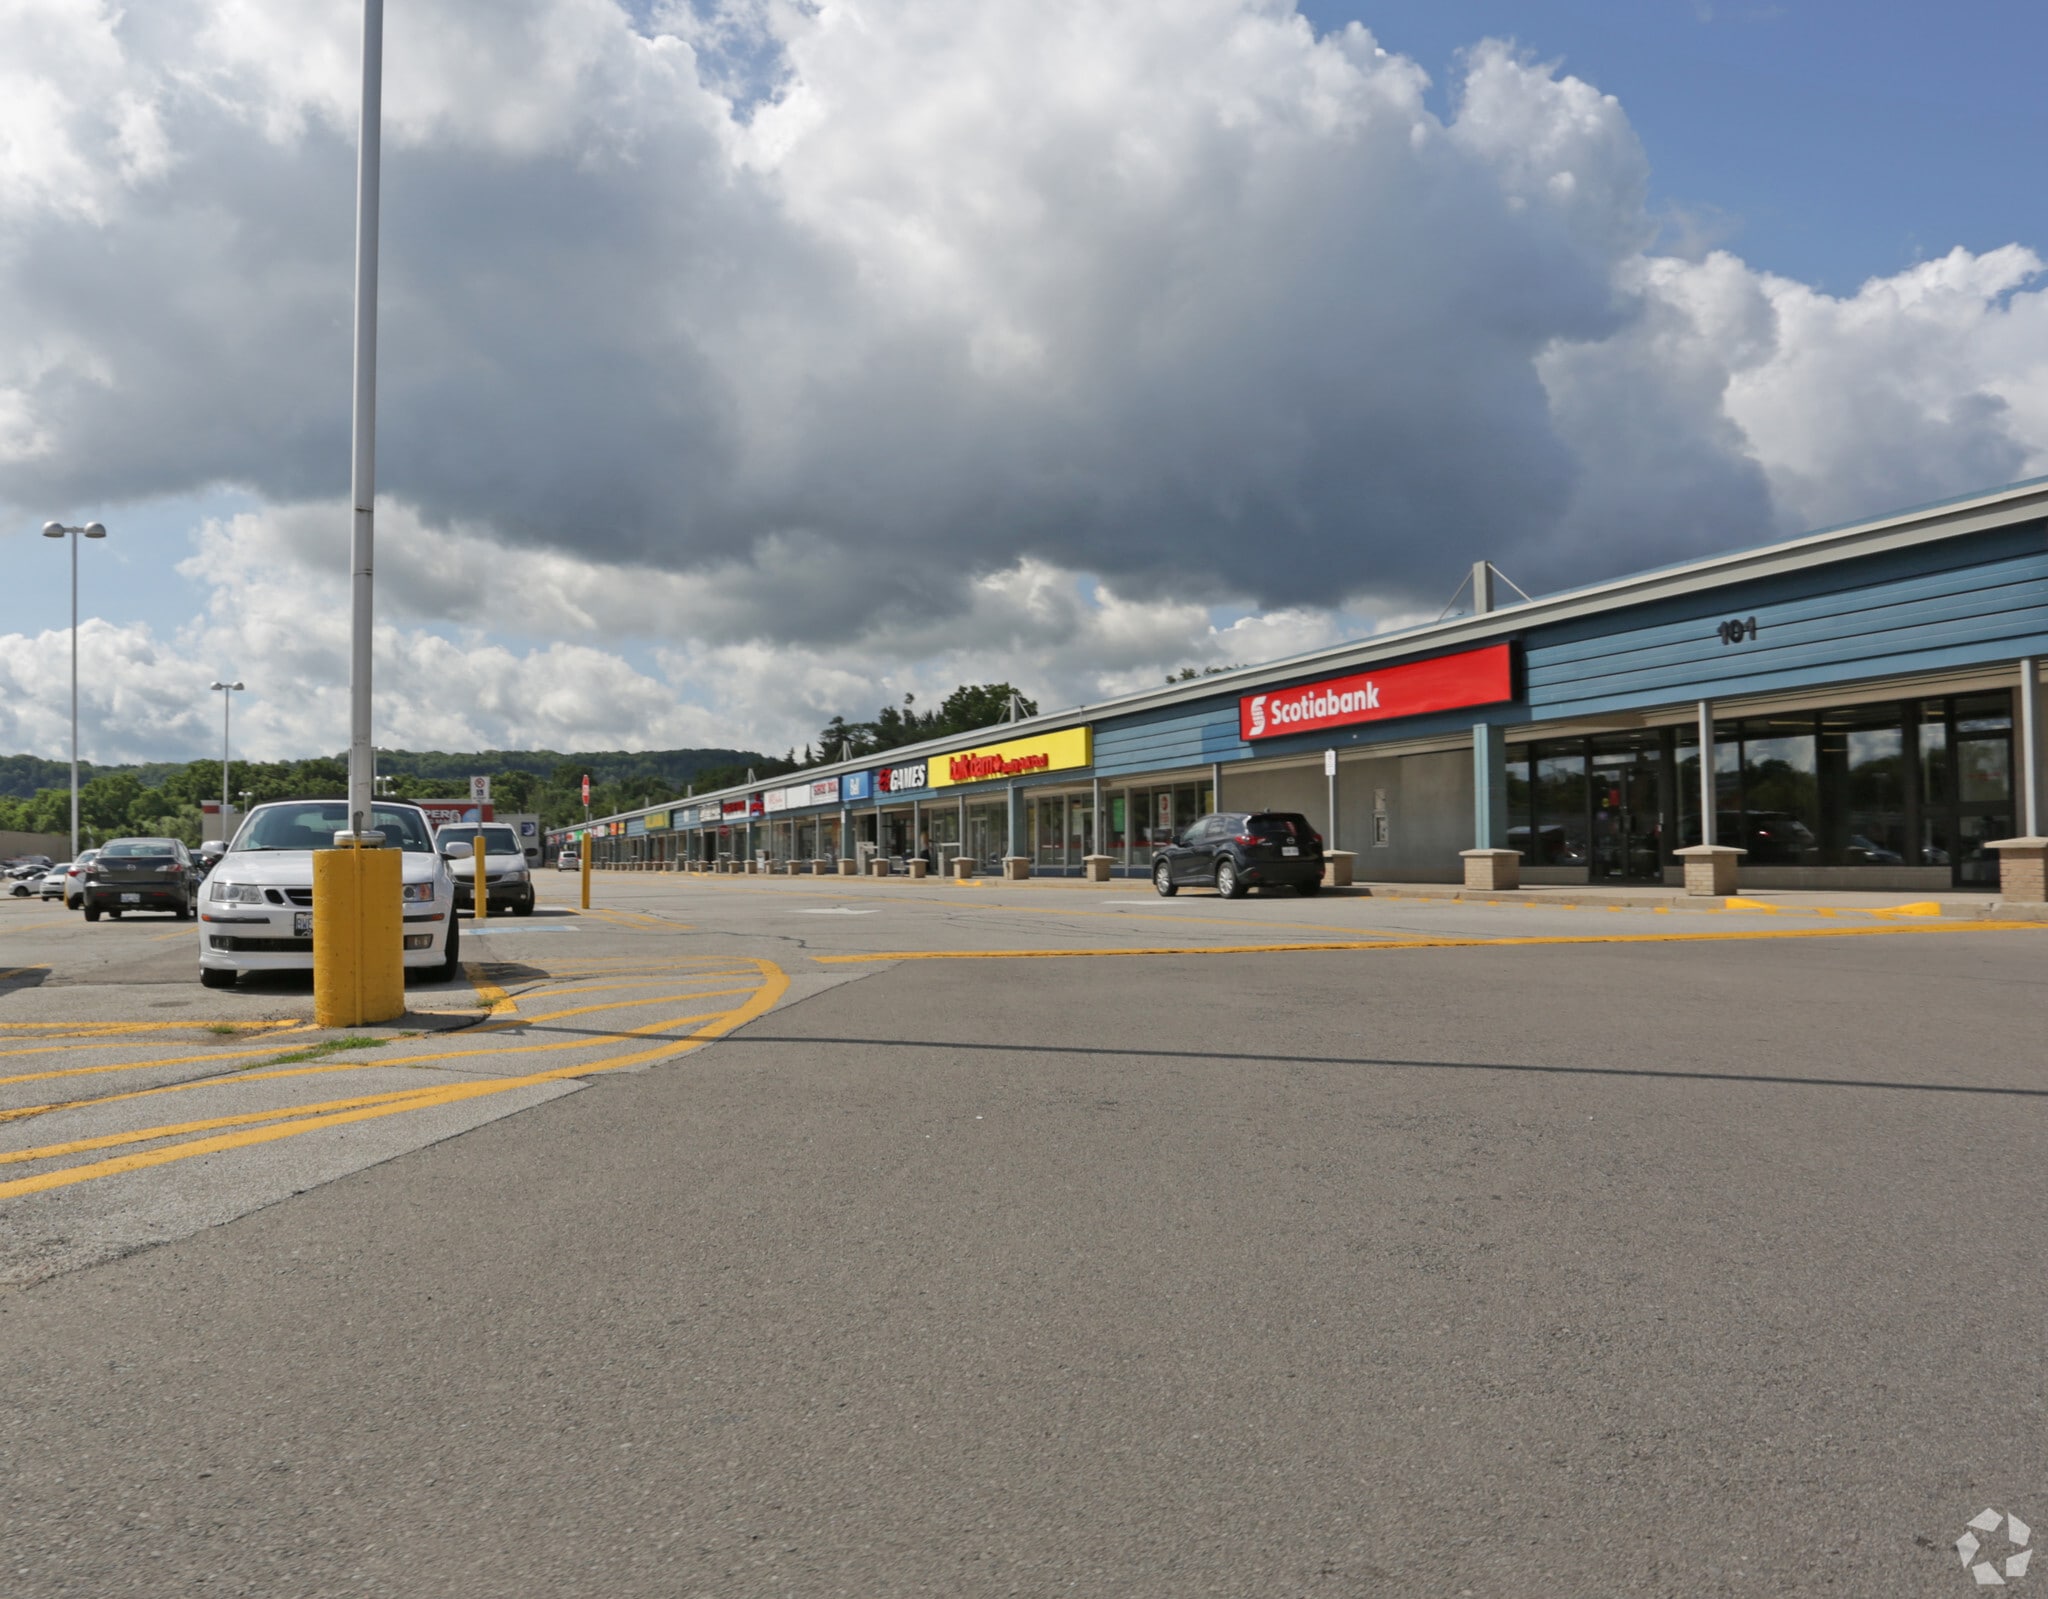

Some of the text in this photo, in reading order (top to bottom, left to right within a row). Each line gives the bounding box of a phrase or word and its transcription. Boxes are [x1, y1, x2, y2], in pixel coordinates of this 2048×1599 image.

[1717, 616, 1757, 645] 101
[1270, 681, 1381, 726] Scotiabank
[889, 764, 926, 791] GAMES
